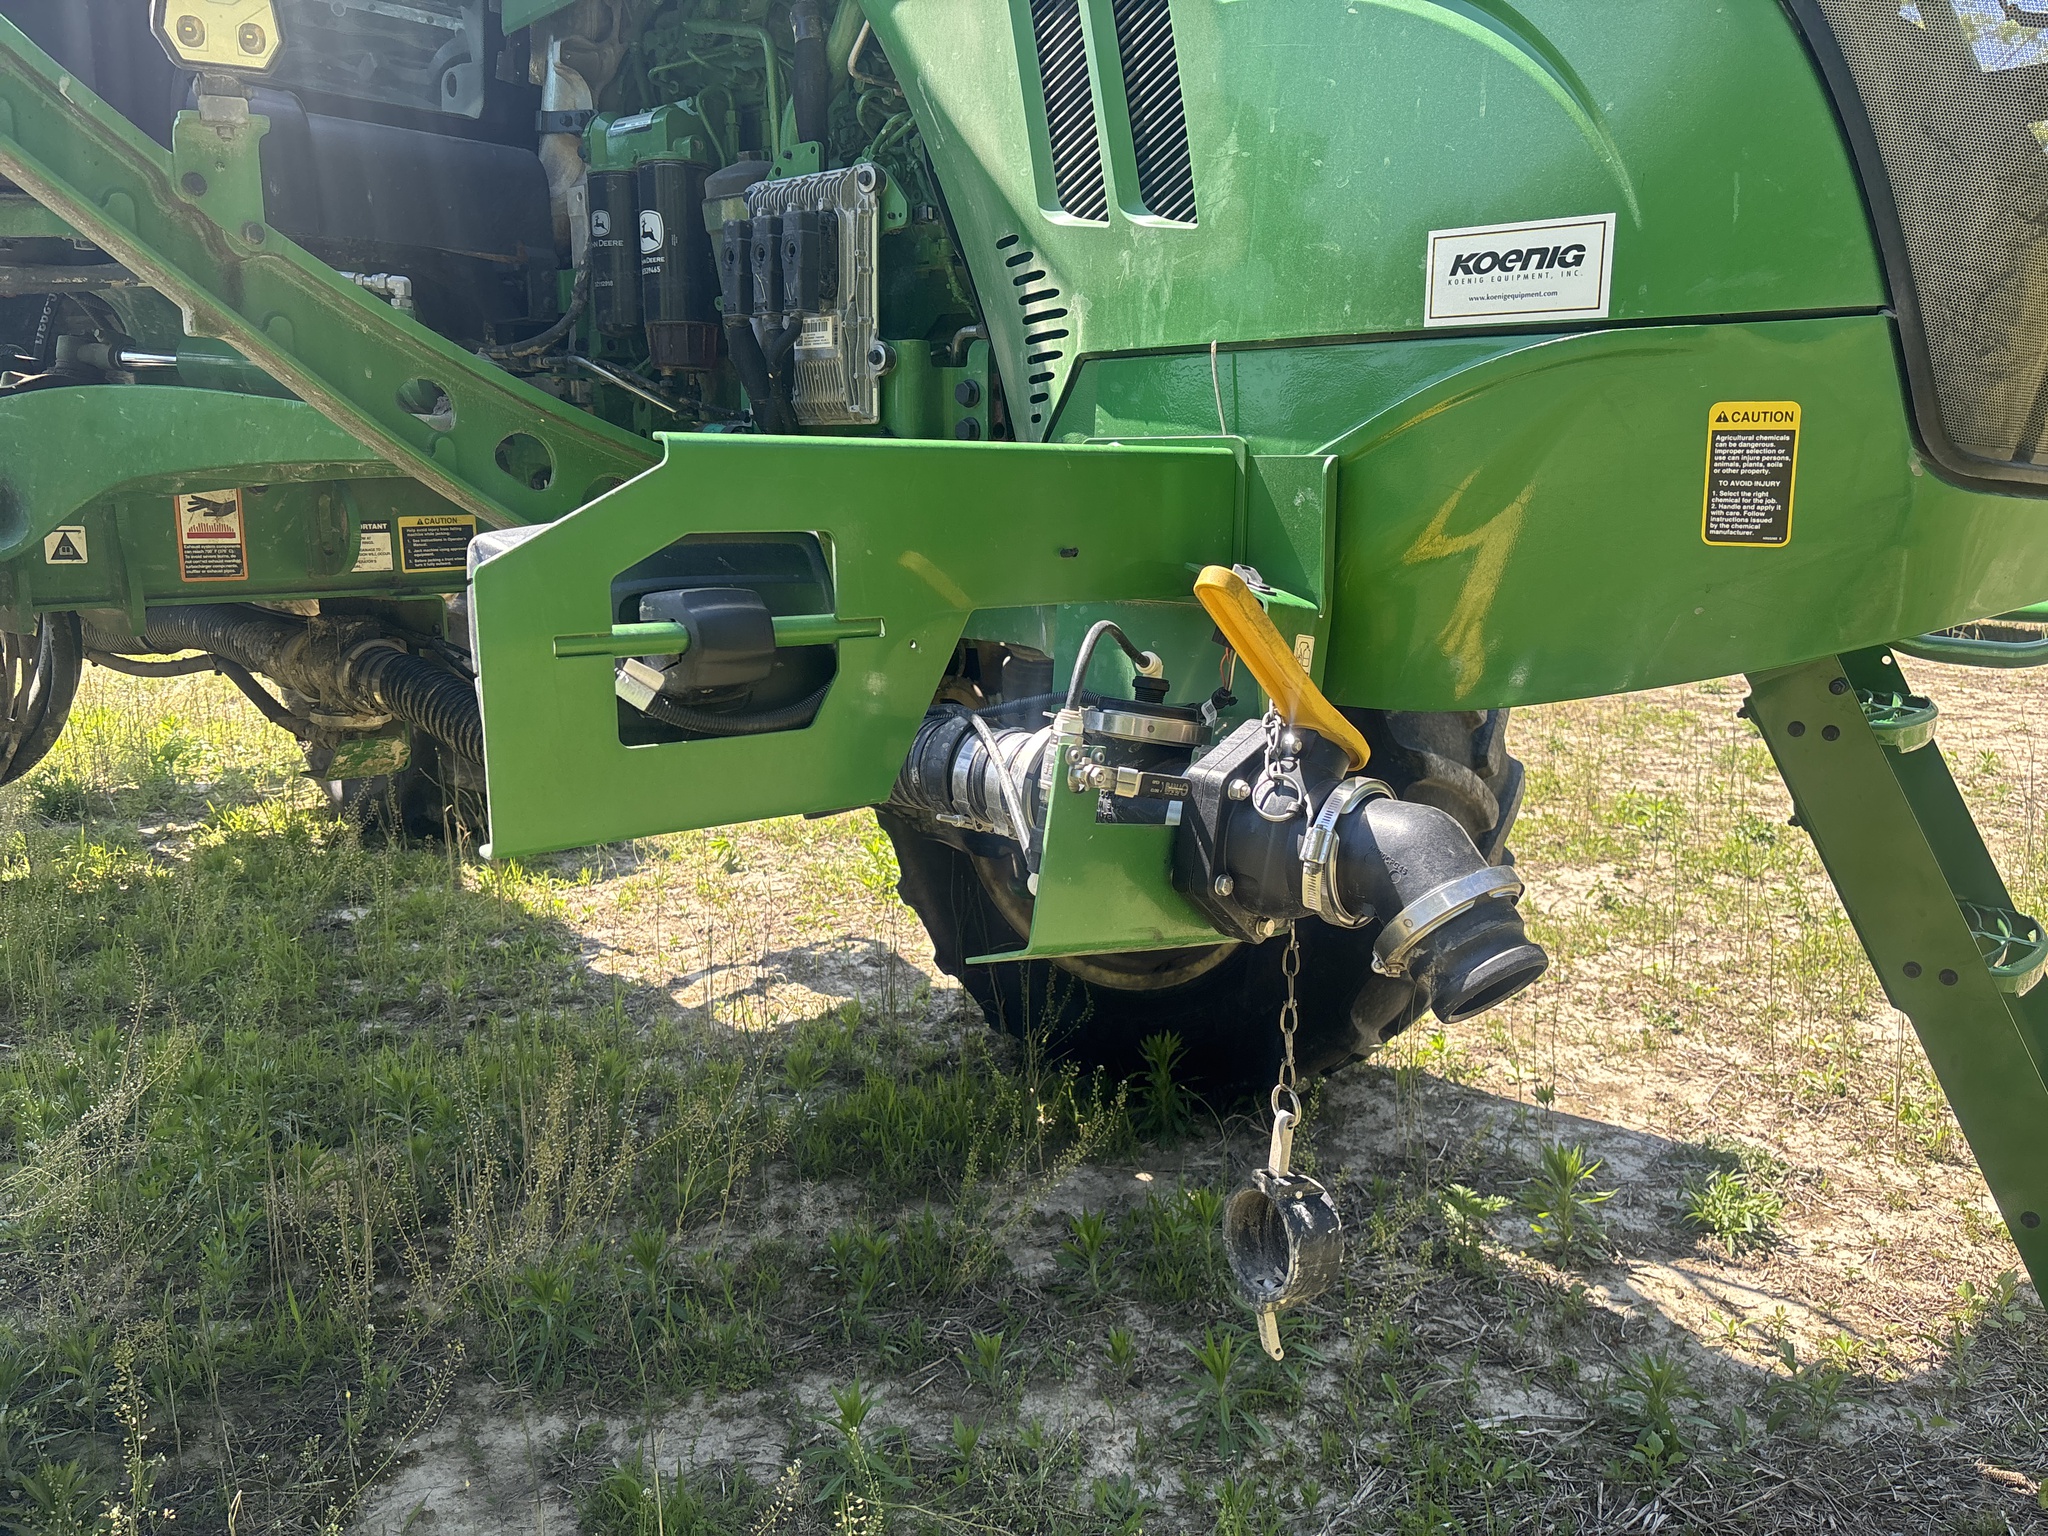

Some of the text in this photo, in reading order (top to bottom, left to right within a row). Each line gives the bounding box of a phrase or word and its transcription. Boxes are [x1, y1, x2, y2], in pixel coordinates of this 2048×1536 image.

[1448, 277, 1484, 286] KOENIG
[1491, 272, 1554, 283] EQUIPMENT,
[1468, 290, 1558, 302] www.koenigequipment.com
[1731, 411, 1794, 422] CAUTION
